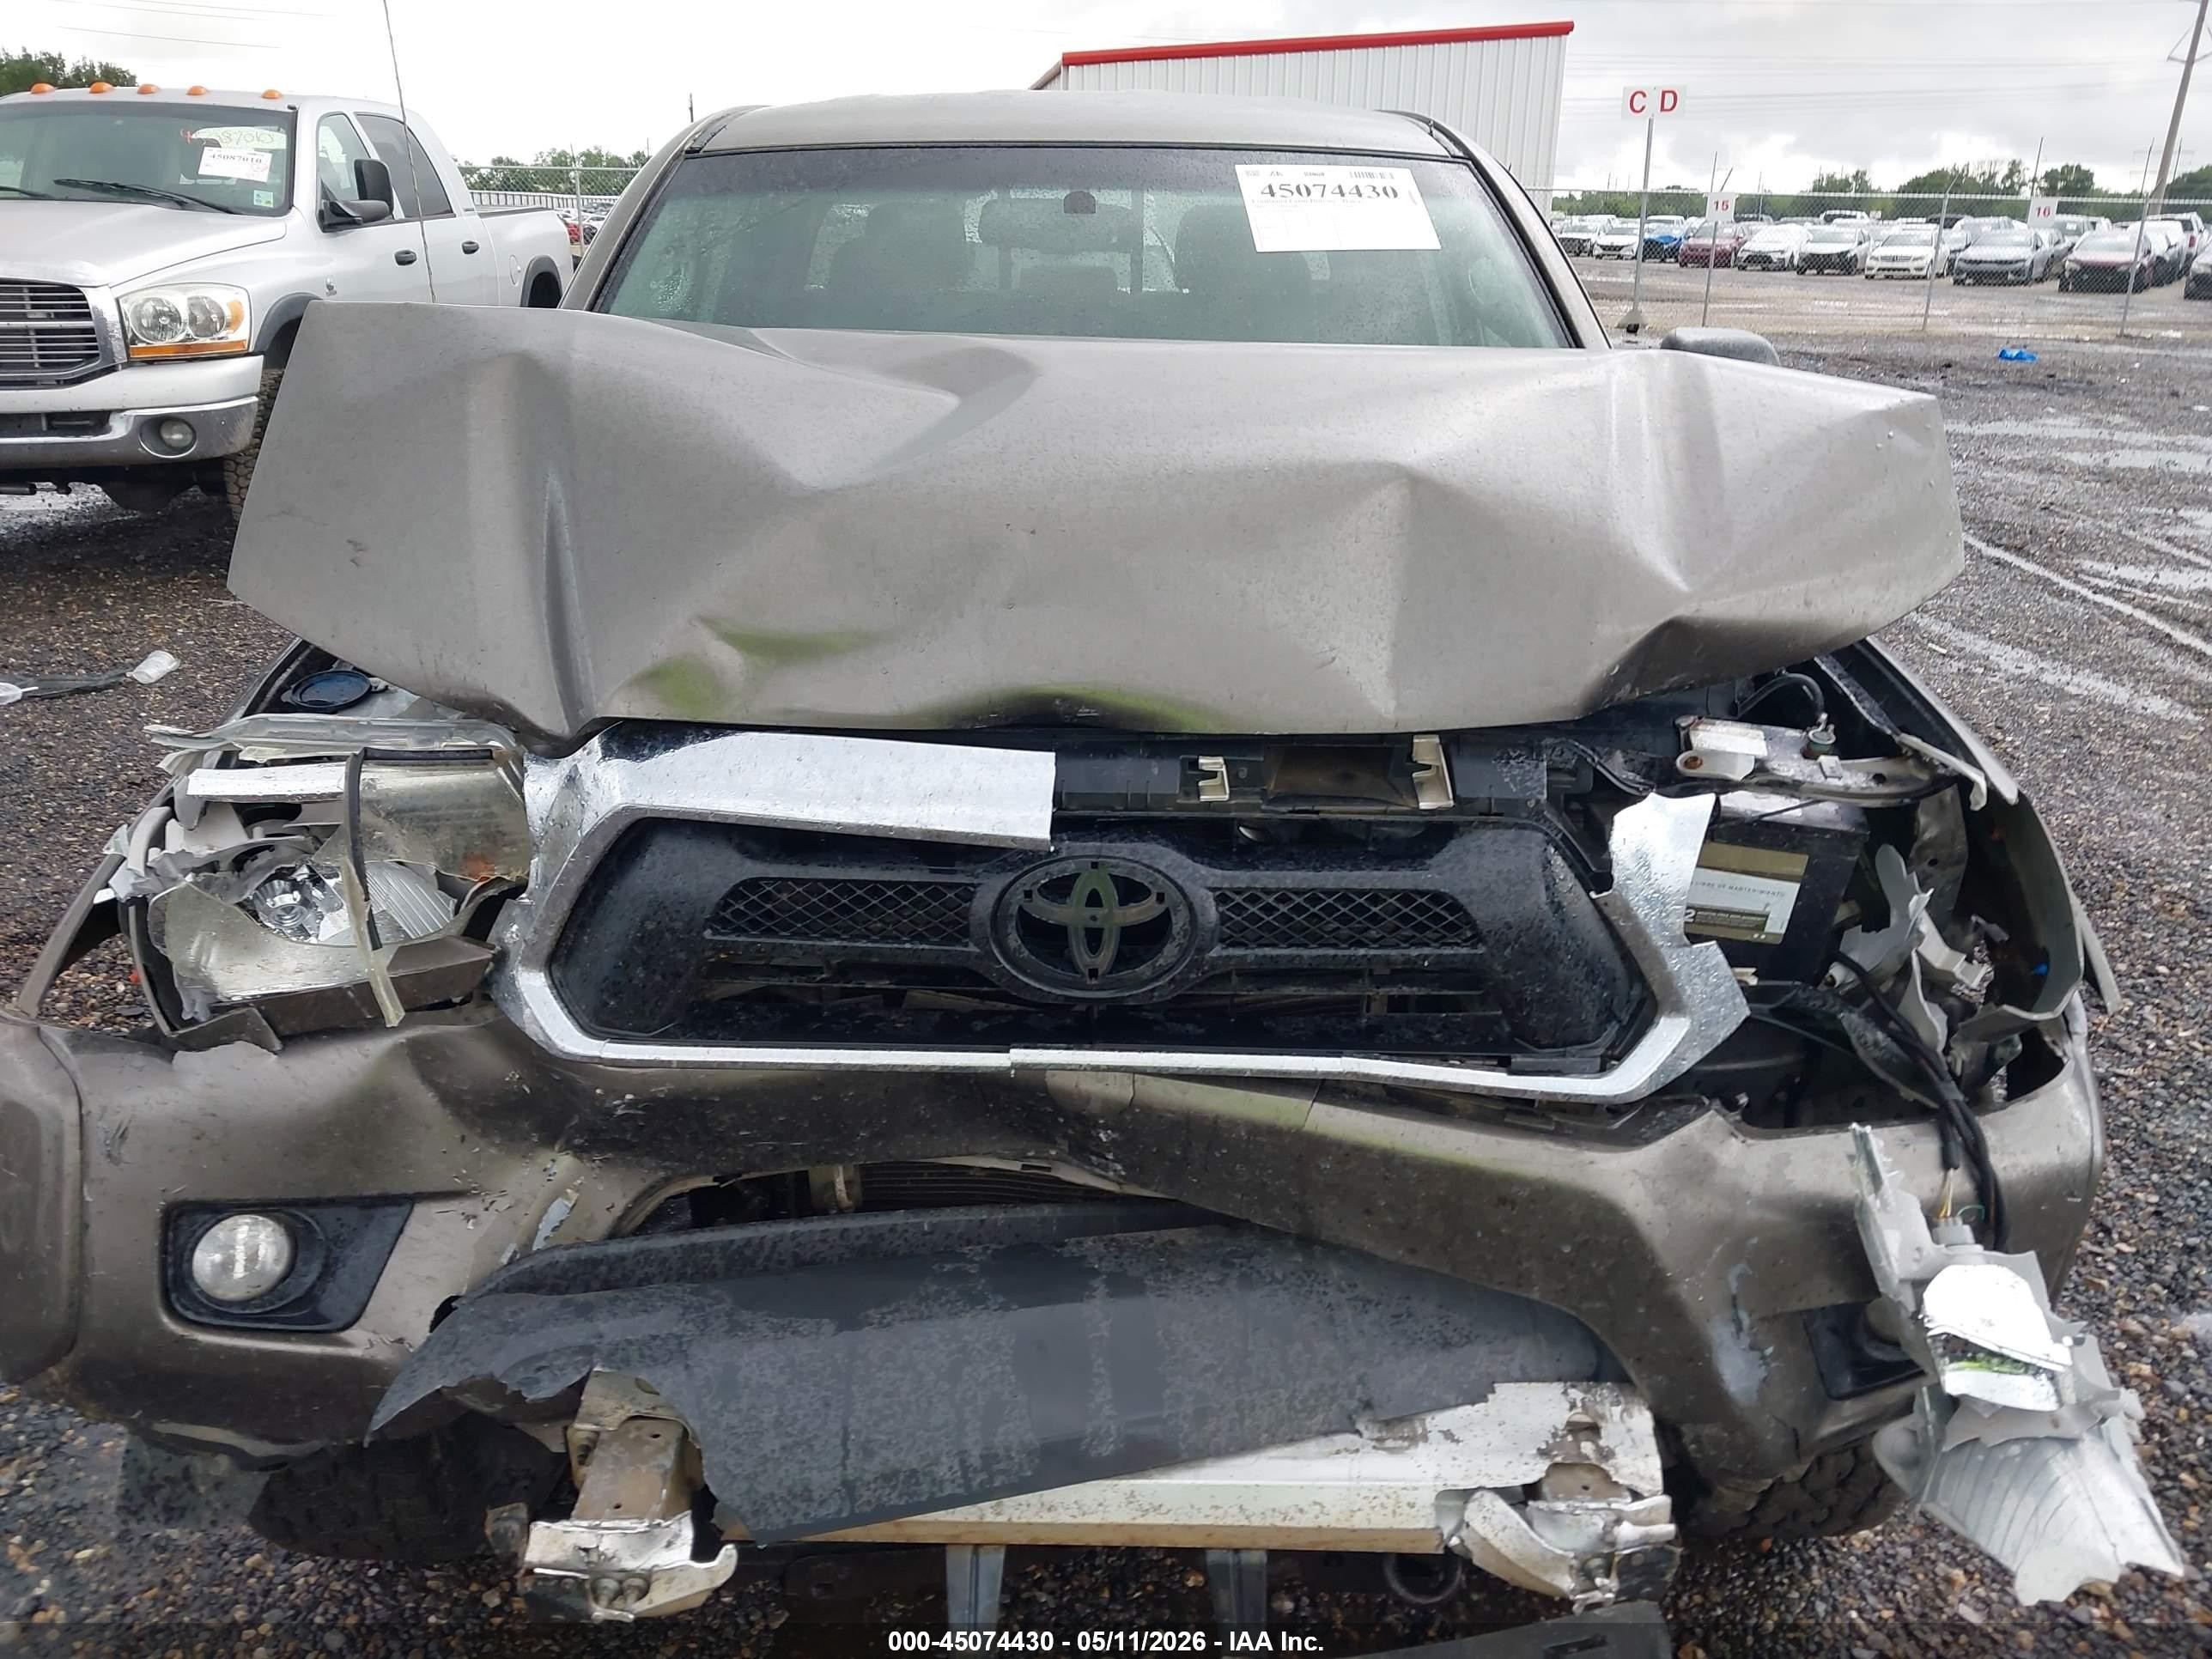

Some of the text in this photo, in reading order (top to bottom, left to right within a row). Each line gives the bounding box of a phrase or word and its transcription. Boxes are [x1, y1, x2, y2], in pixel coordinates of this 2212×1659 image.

[1629, 90, 1678, 113] C D
[1261, 184, 1398, 198] 45074430
[1714, 199, 1729, 211] 15
